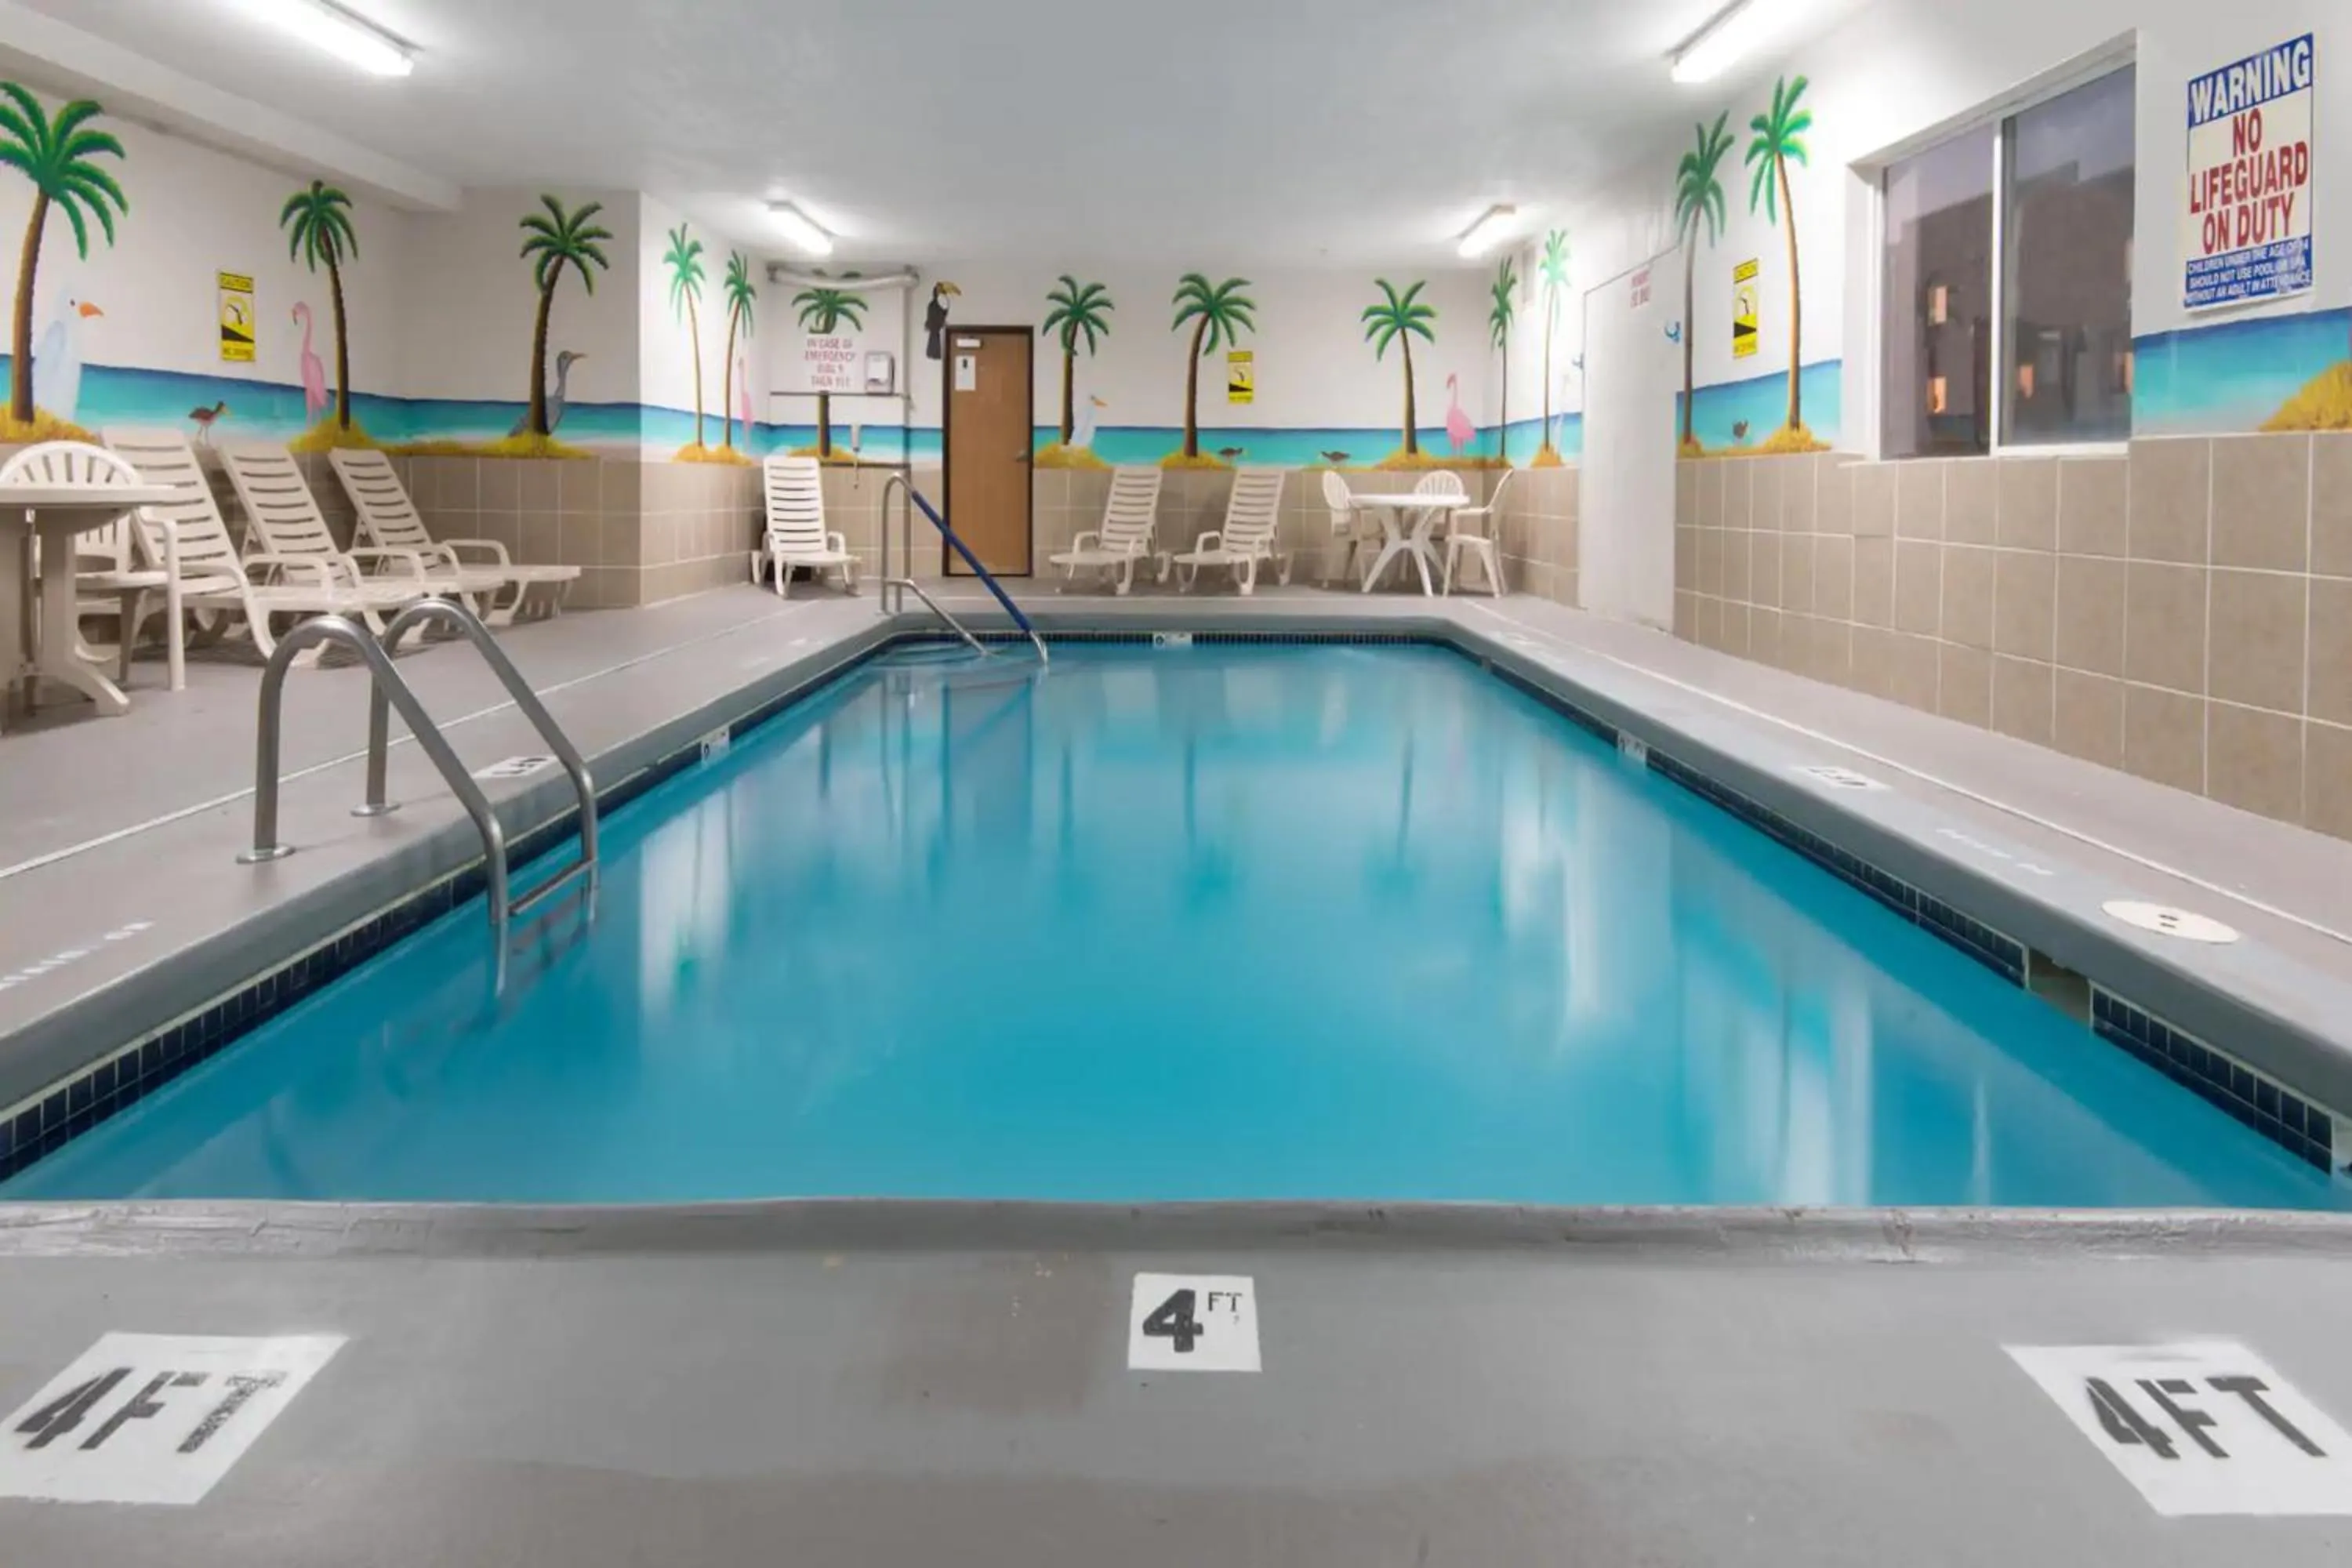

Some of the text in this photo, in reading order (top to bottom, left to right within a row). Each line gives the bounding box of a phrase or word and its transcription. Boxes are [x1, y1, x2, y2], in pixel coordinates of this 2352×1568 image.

[2191, 40, 2310, 124] WARNING
[2234, 108, 2262, 158] NO
[2190, 141, 2308, 215] LIFEGUARD
[2203, 192, 2295, 255] ON DUTY
[2237, 266, 2252, 280] USE
[2254, 261, 2274, 277] POOL
[1142, 1288, 1243, 1353] 4 FT
[2085, 1376, 2328, 1460] 4FT
